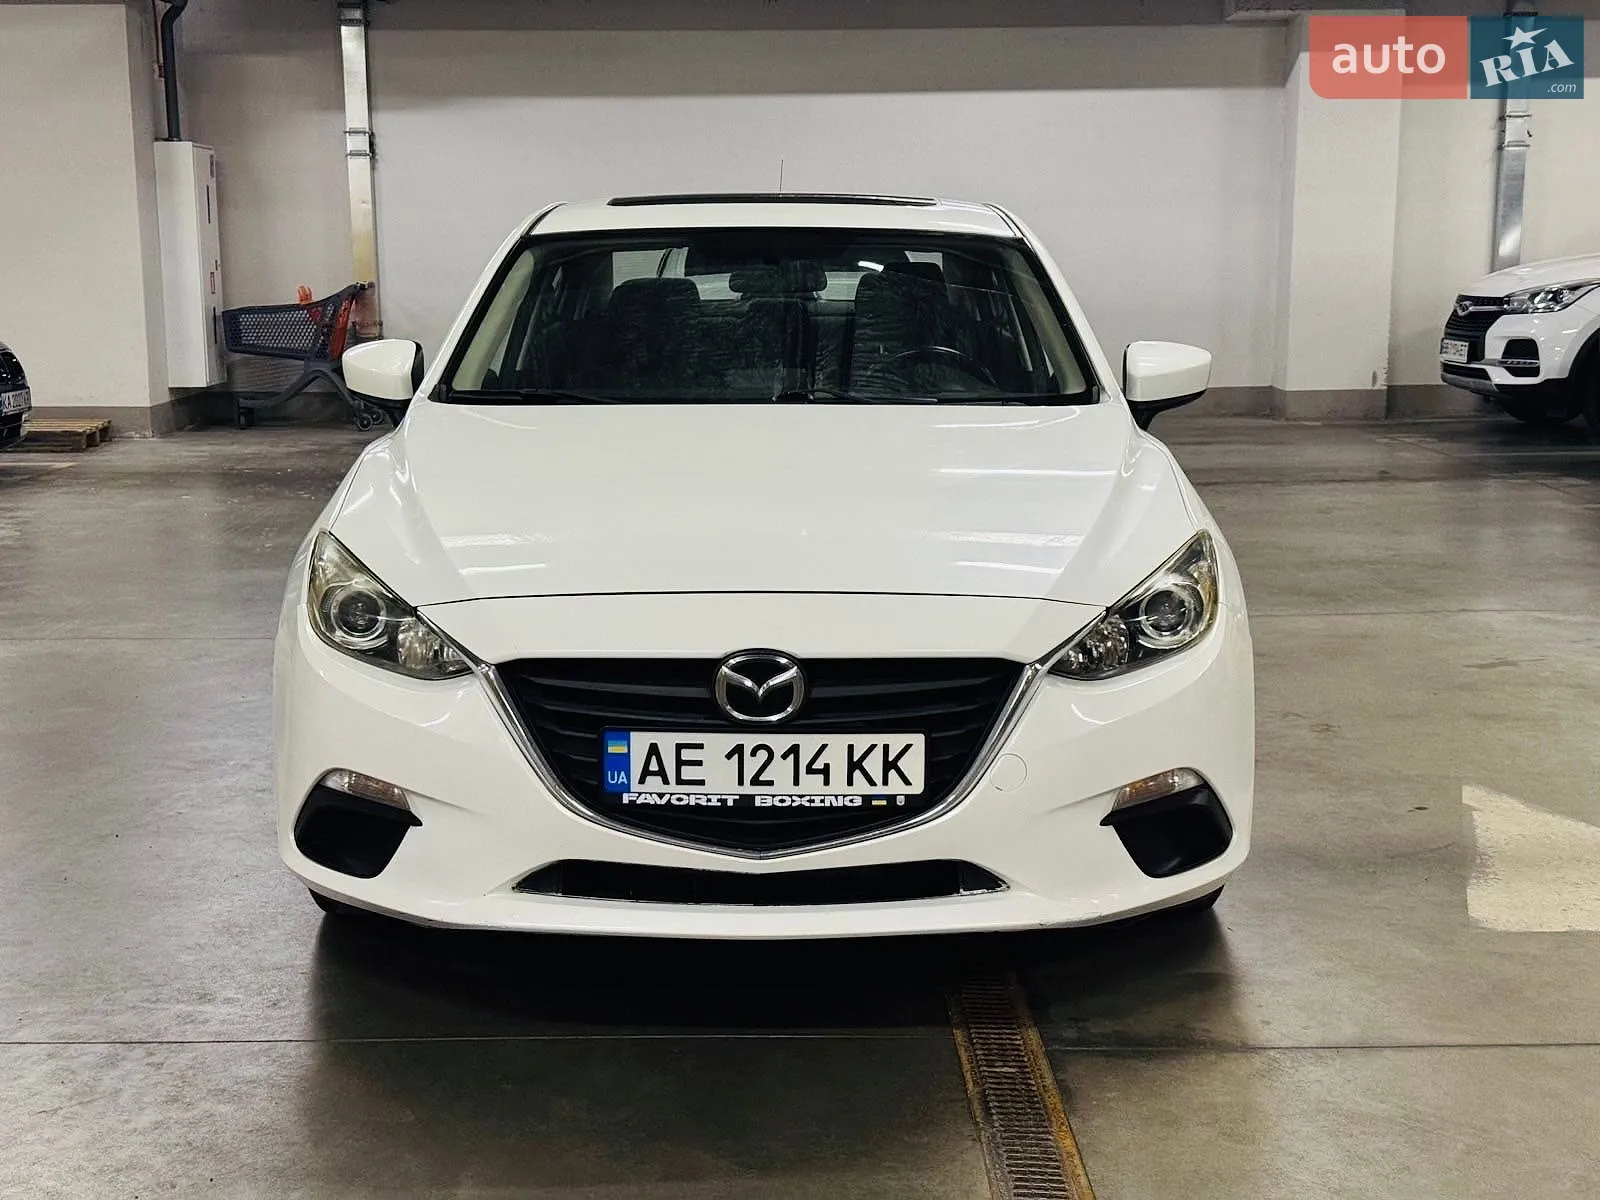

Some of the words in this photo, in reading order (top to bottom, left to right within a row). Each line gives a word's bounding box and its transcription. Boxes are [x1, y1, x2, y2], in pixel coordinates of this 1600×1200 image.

[637, 742, 706, 786] AE
[724, 743, 831, 787] 1214
[846, 743, 914, 787] KK
[607, 770, 628, 785] UA
[621, 792, 740, 807] FAVORIT
[754, 793, 863, 807] BOXING
